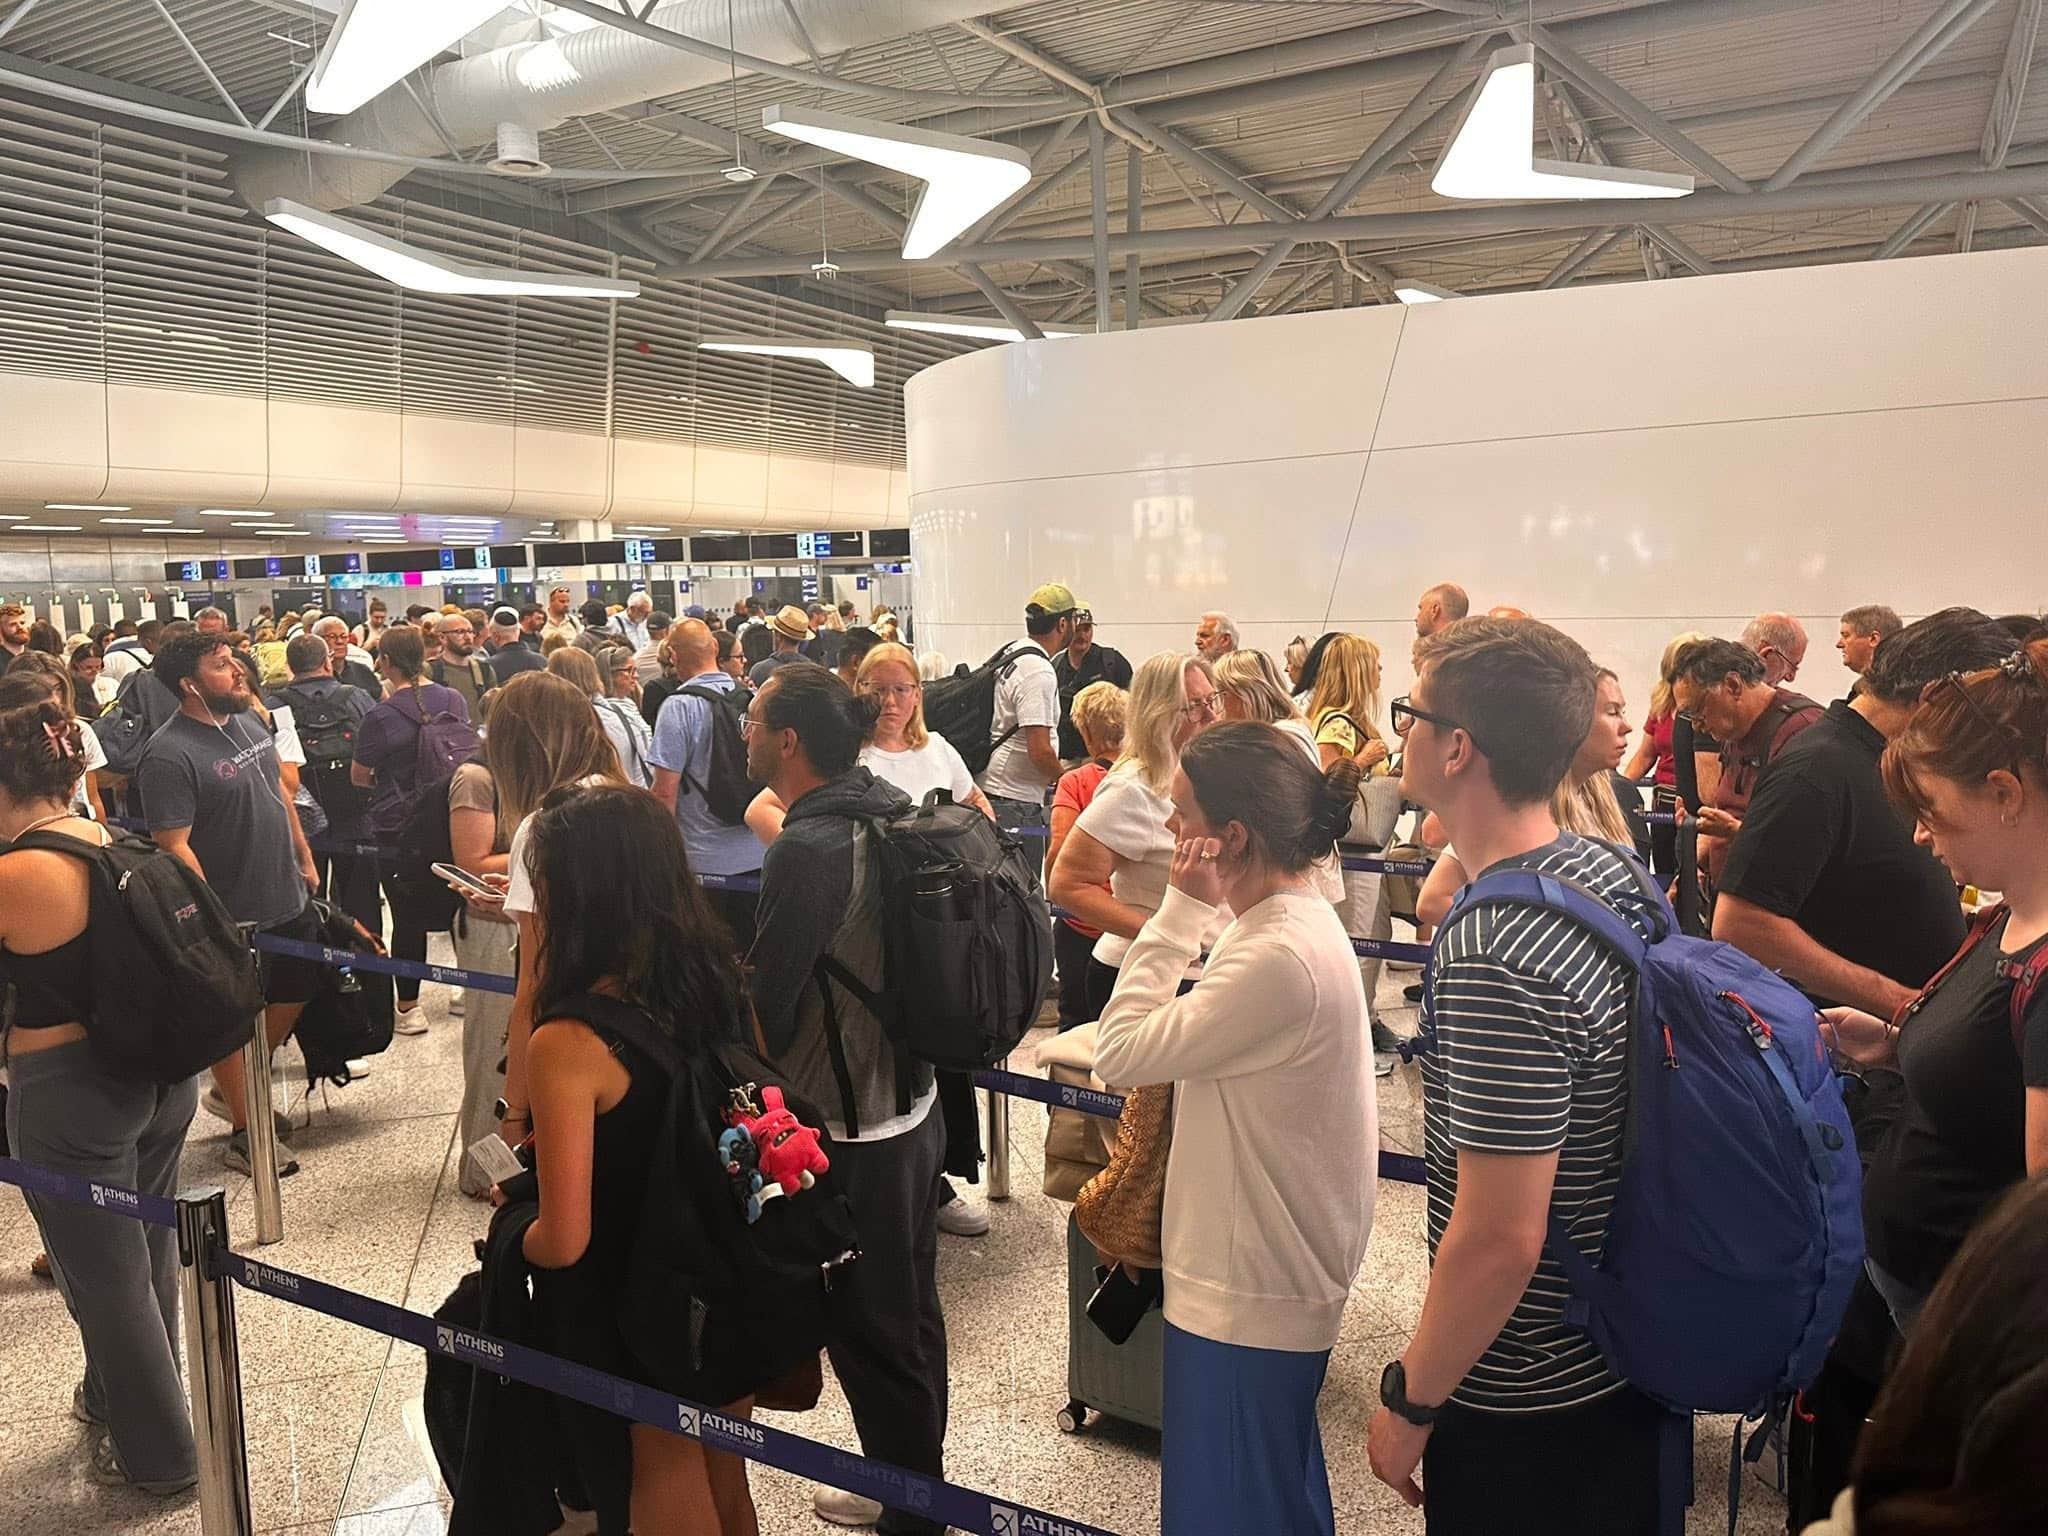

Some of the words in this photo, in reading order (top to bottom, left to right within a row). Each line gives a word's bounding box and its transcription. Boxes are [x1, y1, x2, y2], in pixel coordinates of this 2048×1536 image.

[1395, 863, 1424, 871] ATHENS
[333, 950, 356, 960] ATHENS
[442, 969, 468, 979] ATHENS
[1078, 1090, 1122, 1107] ATHENS
[105, 1187, 138, 1205] ATHENS
[260, 1267, 299, 1289] ATHENS
[455, 1332, 504, 1357] ATHENS
[702, 1412, 764, 1443] ATHENS
